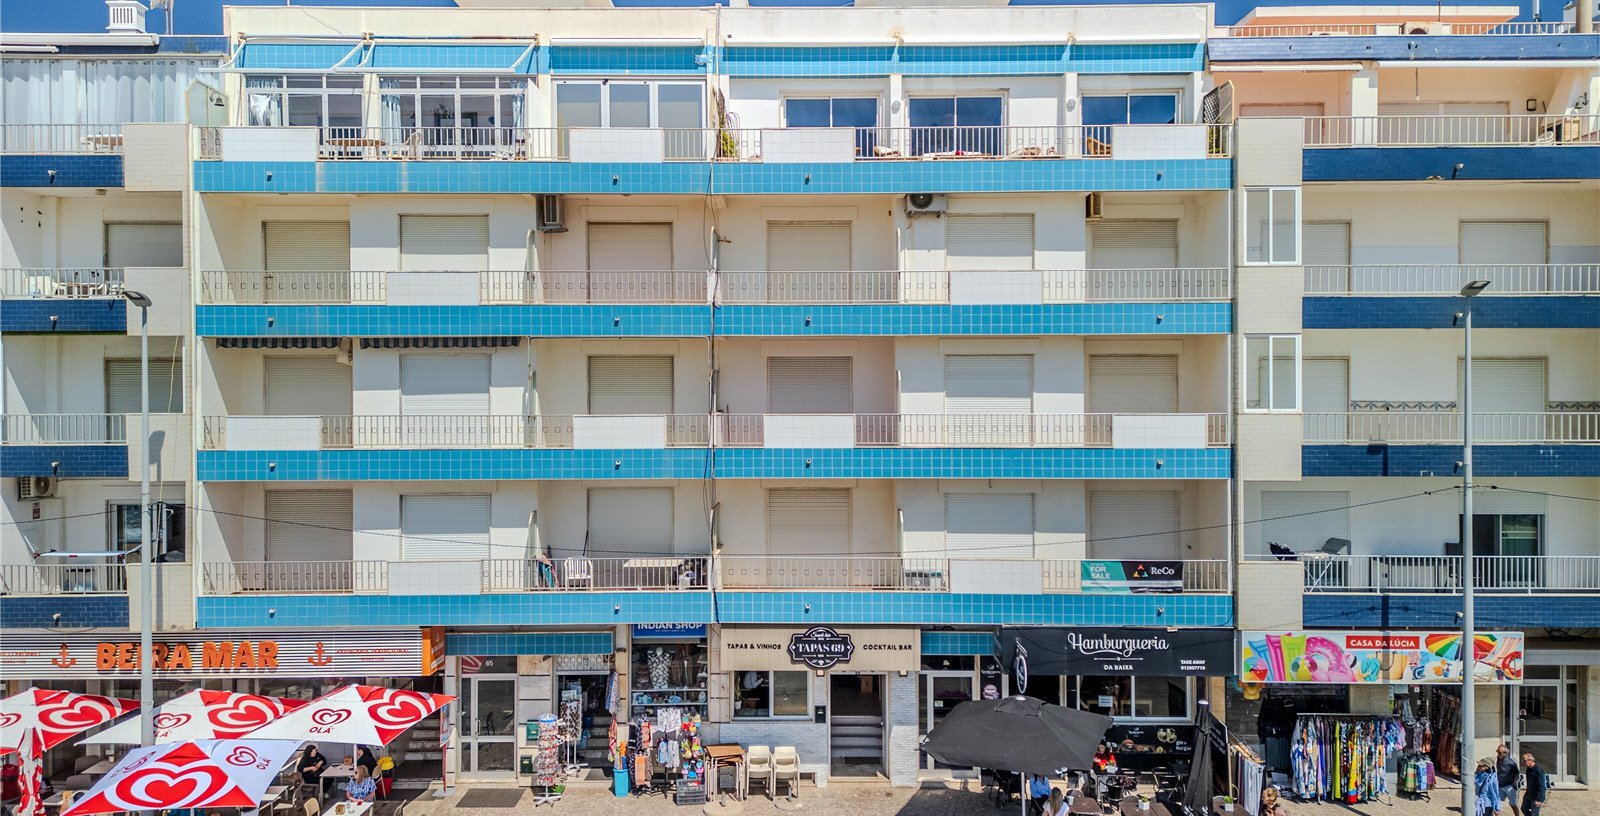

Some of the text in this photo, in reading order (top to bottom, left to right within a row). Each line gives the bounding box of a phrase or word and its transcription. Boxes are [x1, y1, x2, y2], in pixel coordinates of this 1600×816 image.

[1151, 566, 1175, 575] ReCo
[1067, 632, 1170, 658] Hamburgueria
[1350, 638, 1416, 647] CASA DA LÚCIA
[796, 643, 845, 653] TAPAS 69
[202, 640, 279, 670] MAR
[309, 725, 334, 734] OLÁ
[256, 757, 272, 770] OLÁ
